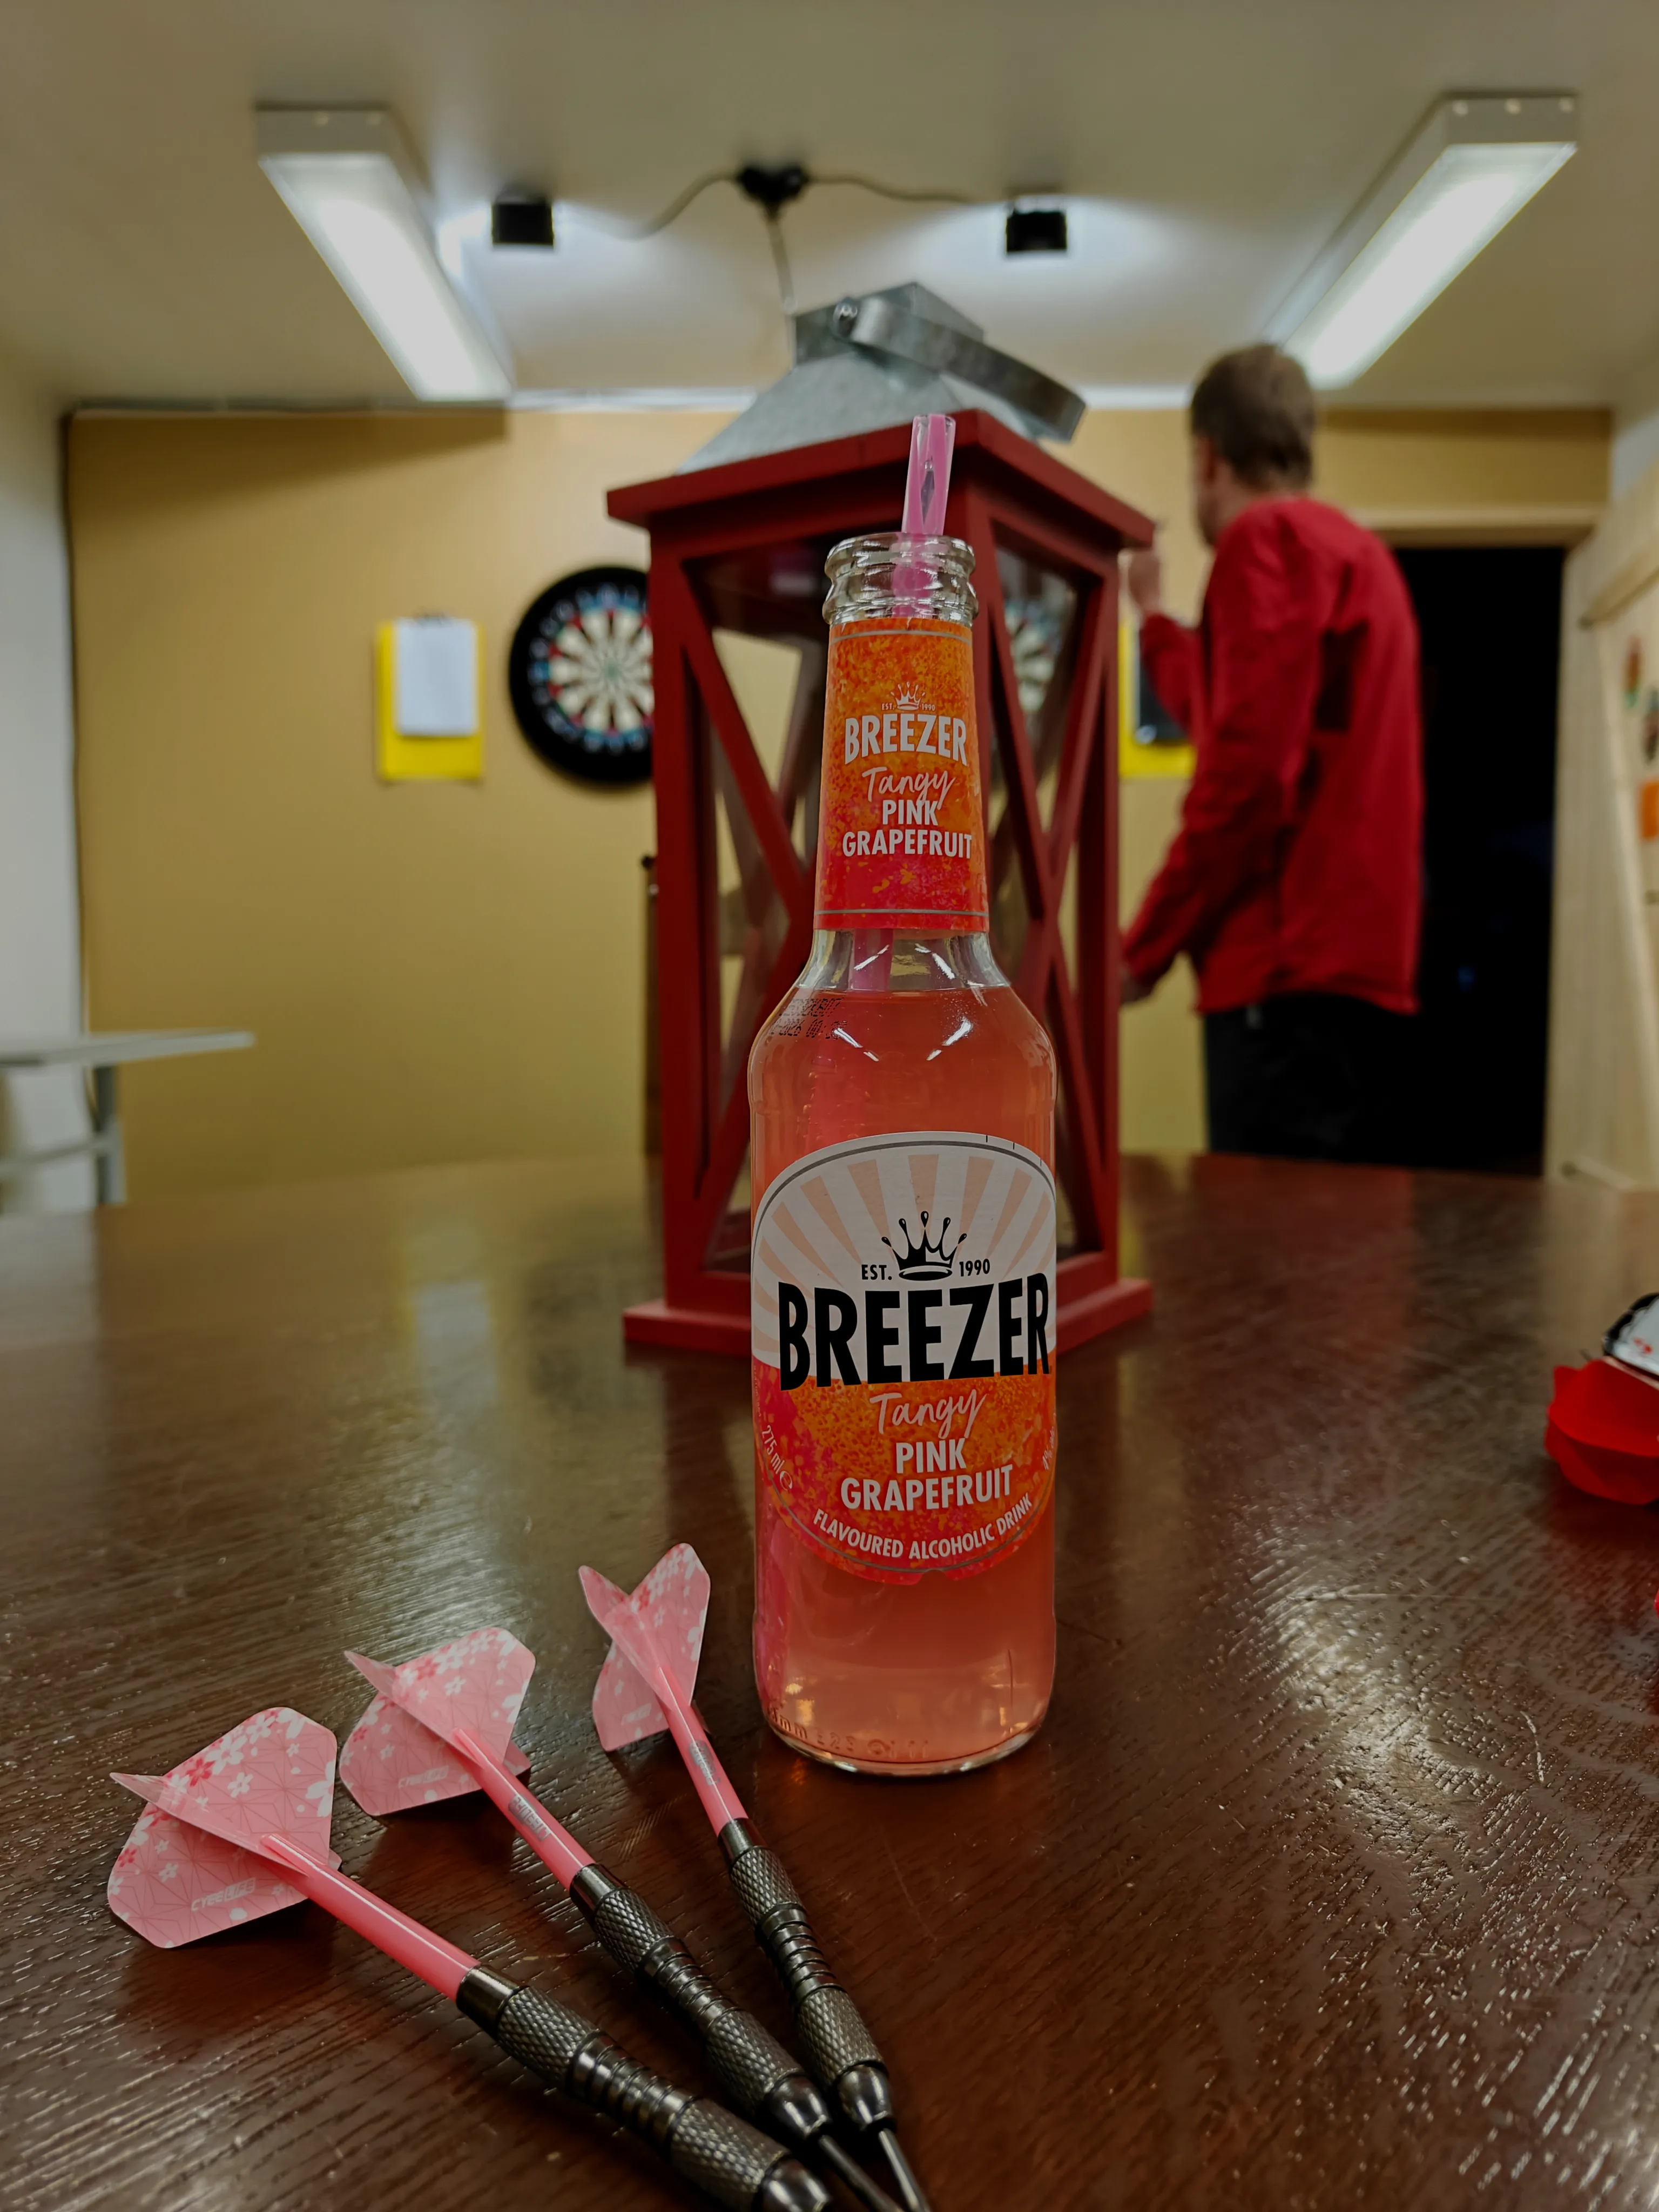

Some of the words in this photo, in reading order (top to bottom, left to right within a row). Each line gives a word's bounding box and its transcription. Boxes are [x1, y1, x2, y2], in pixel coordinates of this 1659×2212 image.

[881, 703, 895, 711] EST.
[921, 703, 936, 711] 1990
[845, 713, 967, 766] BREEZER
[862, 766, 955, 808] Tangy
[882, 799, 938, 826] PINK
[842, 829, 972, 860] GRAPEFRUIT
[861, 1264, 893, 1280] EST.
[959, 1258, 990, 1277] 1990
[778, 1272, 1049, 1391] BREEZER
[869, 1388, 988, 1439] Tangy
[762, 1425, 778, 1455] 275
[895, 1437, 967, 1474] PINK
[765, 1453, 785, 1475] ml
[841, 1464, 1013, 1512] GRAPEFRUIT
[813, 1508, 904, 1559] FLAVOURED
[908, 1523, 995, 1560] ALCOHOLIC
[997, 1493, 1033, 1536] DRINK
